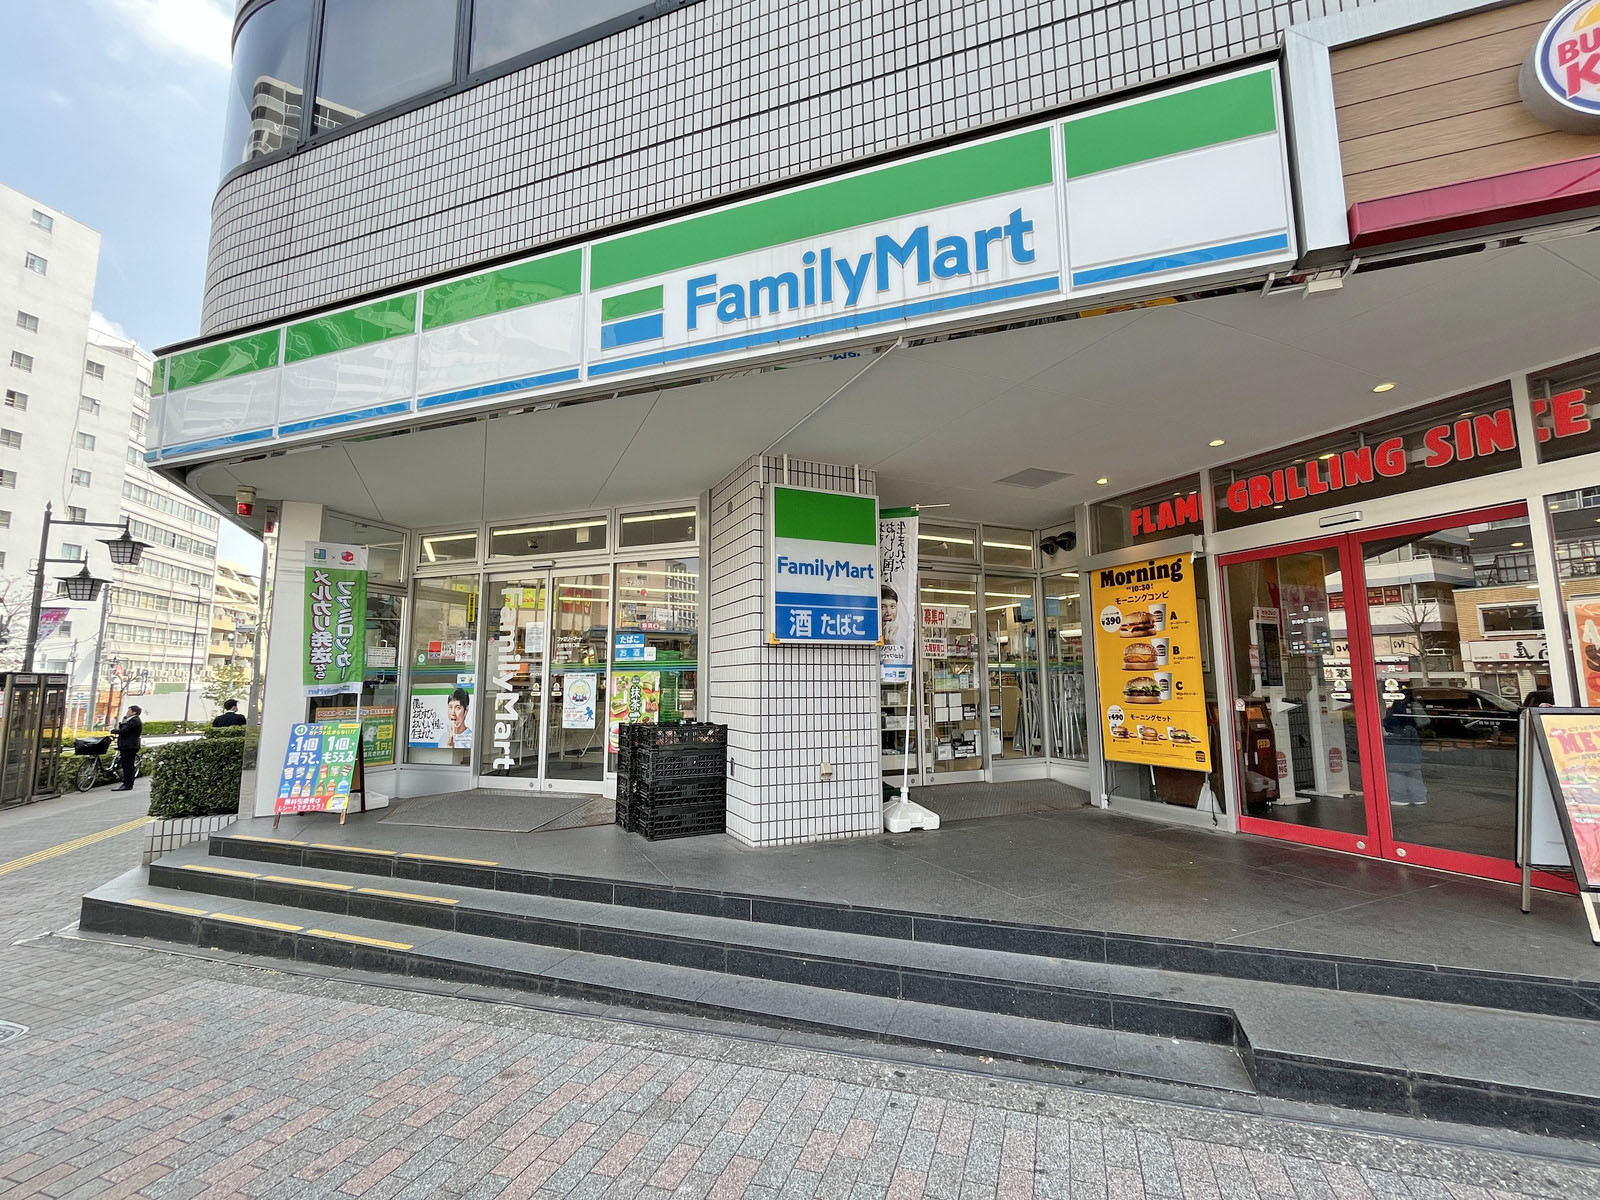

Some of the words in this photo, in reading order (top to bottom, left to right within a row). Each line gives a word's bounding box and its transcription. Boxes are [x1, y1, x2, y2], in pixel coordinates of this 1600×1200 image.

[686, 207, 1037, 331] FamilyMart
[1130, 492, 1204, 536] FLAM
[1226, 436, 1407, 513] GRILLING
[777, 556, 874, 581] FamilyMart
[1100, 557, 1183, 589] Morning
[1115, 590, 1169, 605] モーニングコンビ
[1101, 615, 1121, 626] ¥390
[1169, 610, 1178, 621] A
[789, 608, 813, 637] 酒
[821, 613, 866, 636] たばこ
[619, 635, 641, 645] たばこ
[1172, 646, 1180, 655] B
[492, 588, 524, 770] FamilyMart
[1175, 681, 1183, 690] C
[1130, 713, 1171, 722] モーニングセット
[322, 752, 355, 764] もらえる
